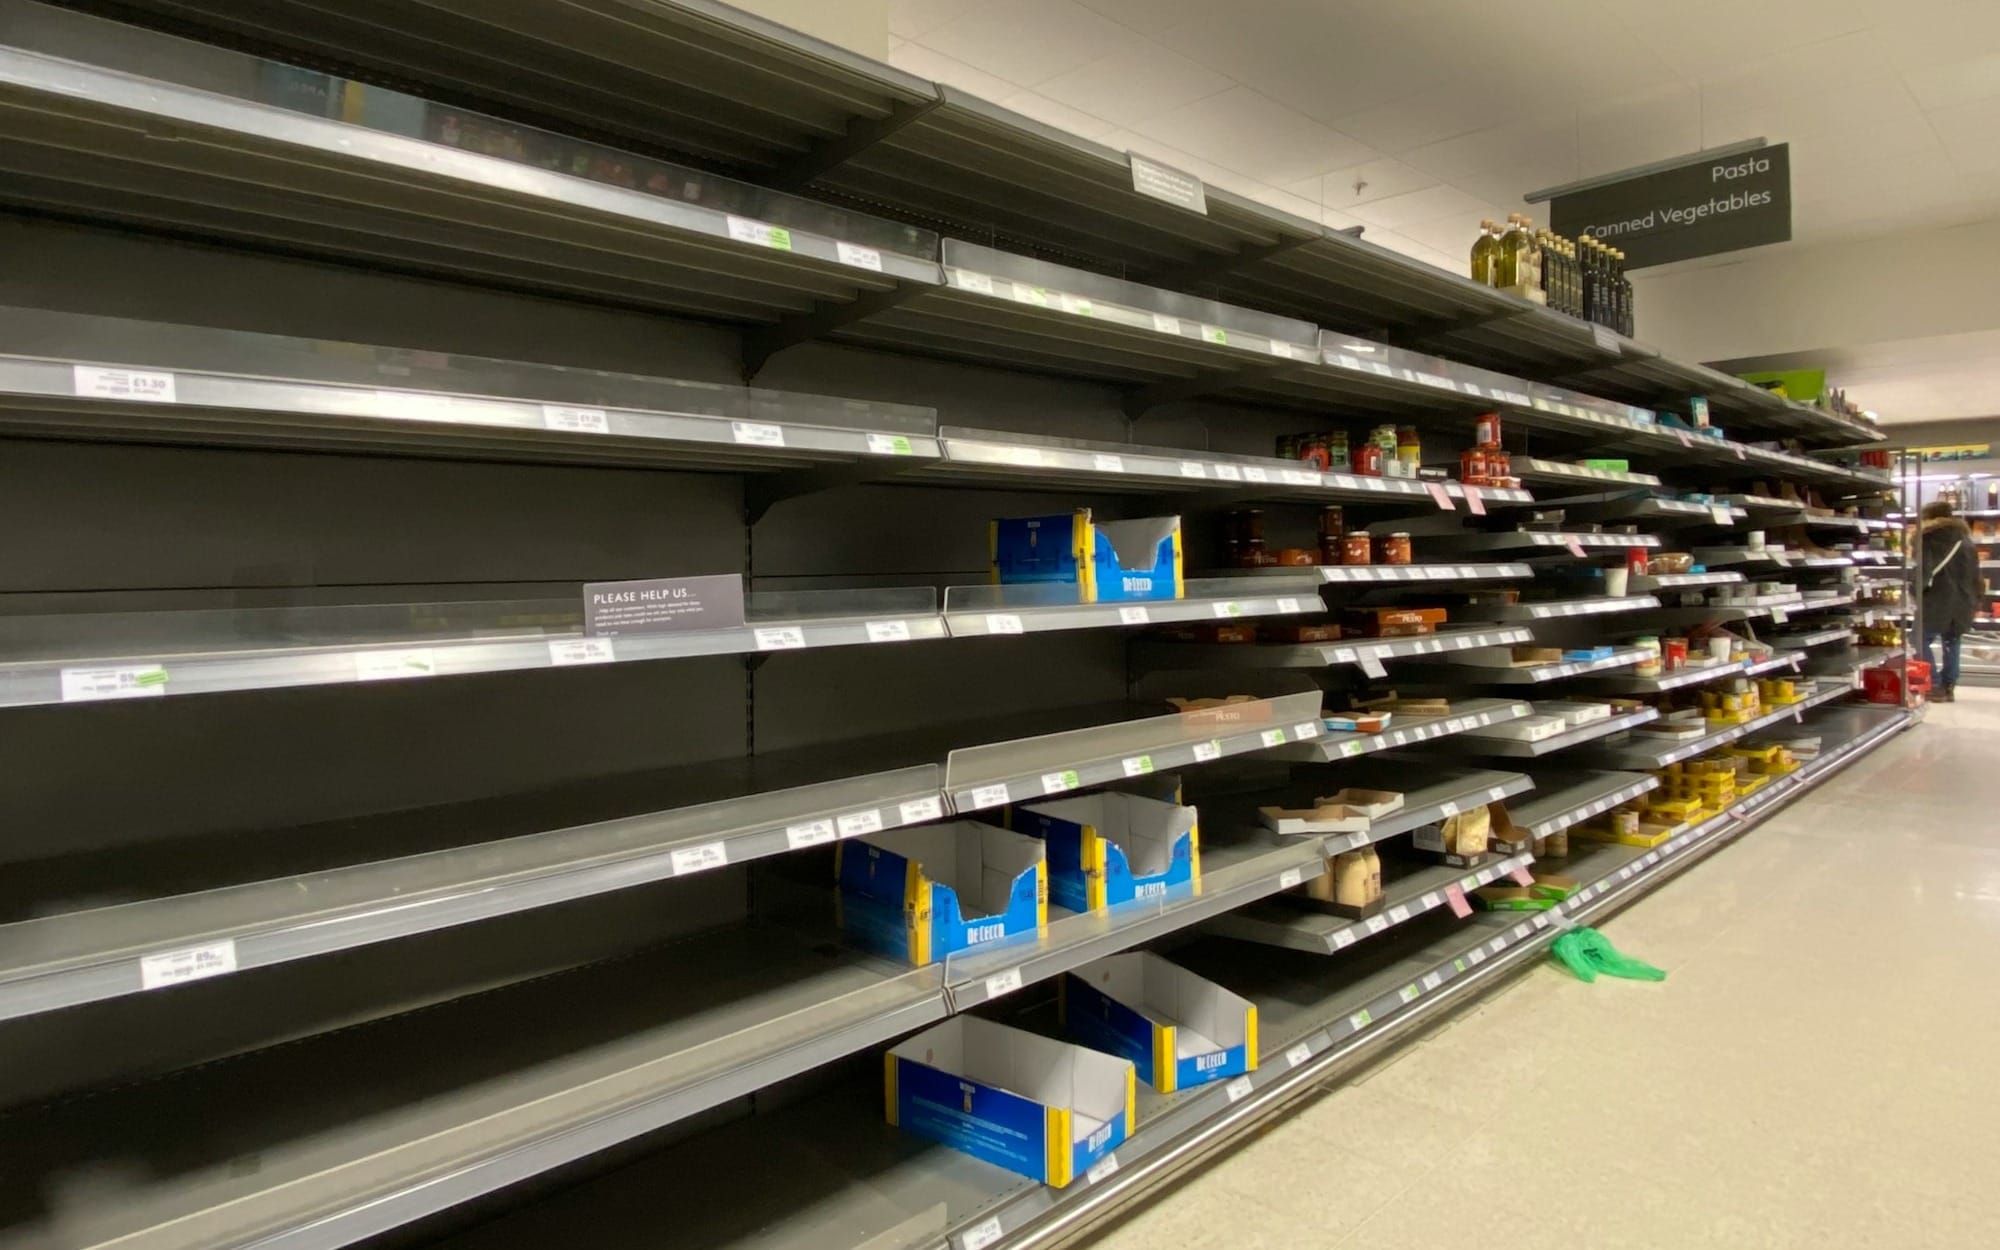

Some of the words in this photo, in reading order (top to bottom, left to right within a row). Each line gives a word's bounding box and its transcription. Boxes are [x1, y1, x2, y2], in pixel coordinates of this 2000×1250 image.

[1712, 157, 1769, 182] Pasta
[1583, 211, 1654, 239] Canned
[1659, 190, 1772, 225] Vegetables
[593, 592, 636, 605] PLEASE
[640, 589, 669, 601] HELP
